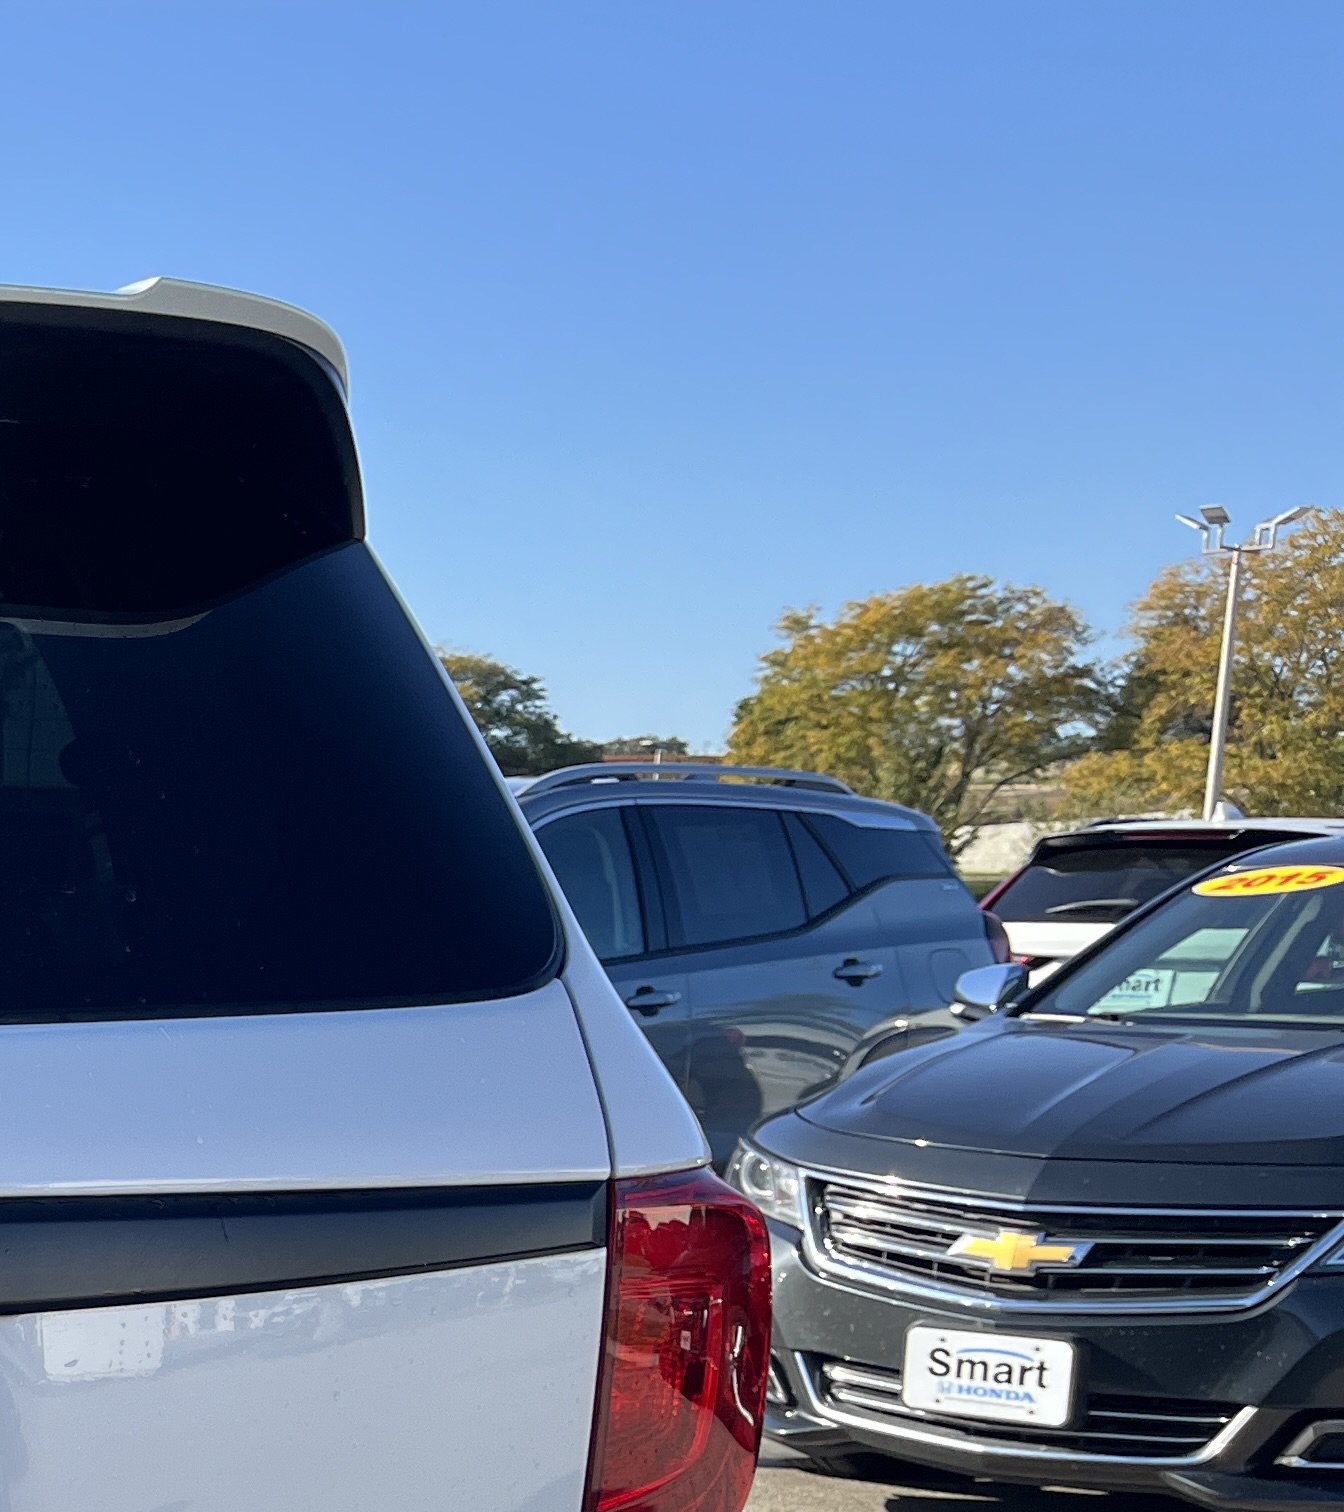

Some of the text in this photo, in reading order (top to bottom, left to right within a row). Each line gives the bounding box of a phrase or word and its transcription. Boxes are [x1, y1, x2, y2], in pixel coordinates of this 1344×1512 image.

[1212, 871, 1334, 891] 2015
[928, 1347, 1048, 1388] Smart
[957, 1384, 1035, 1403] HONDA
